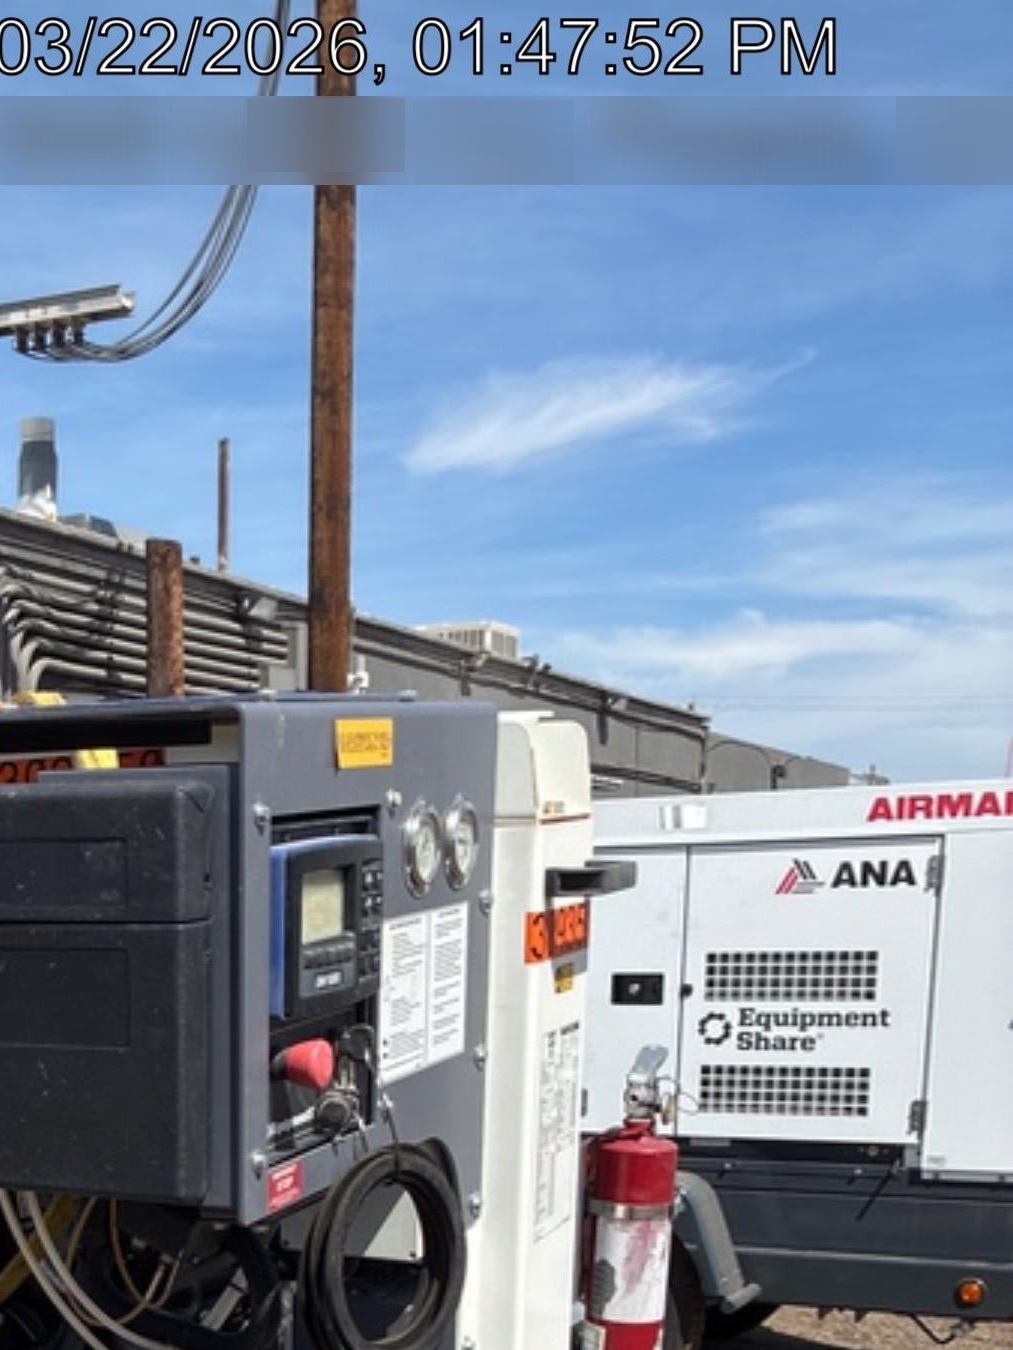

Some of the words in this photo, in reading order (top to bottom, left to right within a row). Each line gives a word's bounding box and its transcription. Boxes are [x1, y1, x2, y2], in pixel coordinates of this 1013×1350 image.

[867, 790, 1013, 822] AIRMA
[830, 860, 916, 888] ANA
[738, 1007, 890, 1031] Equipment
